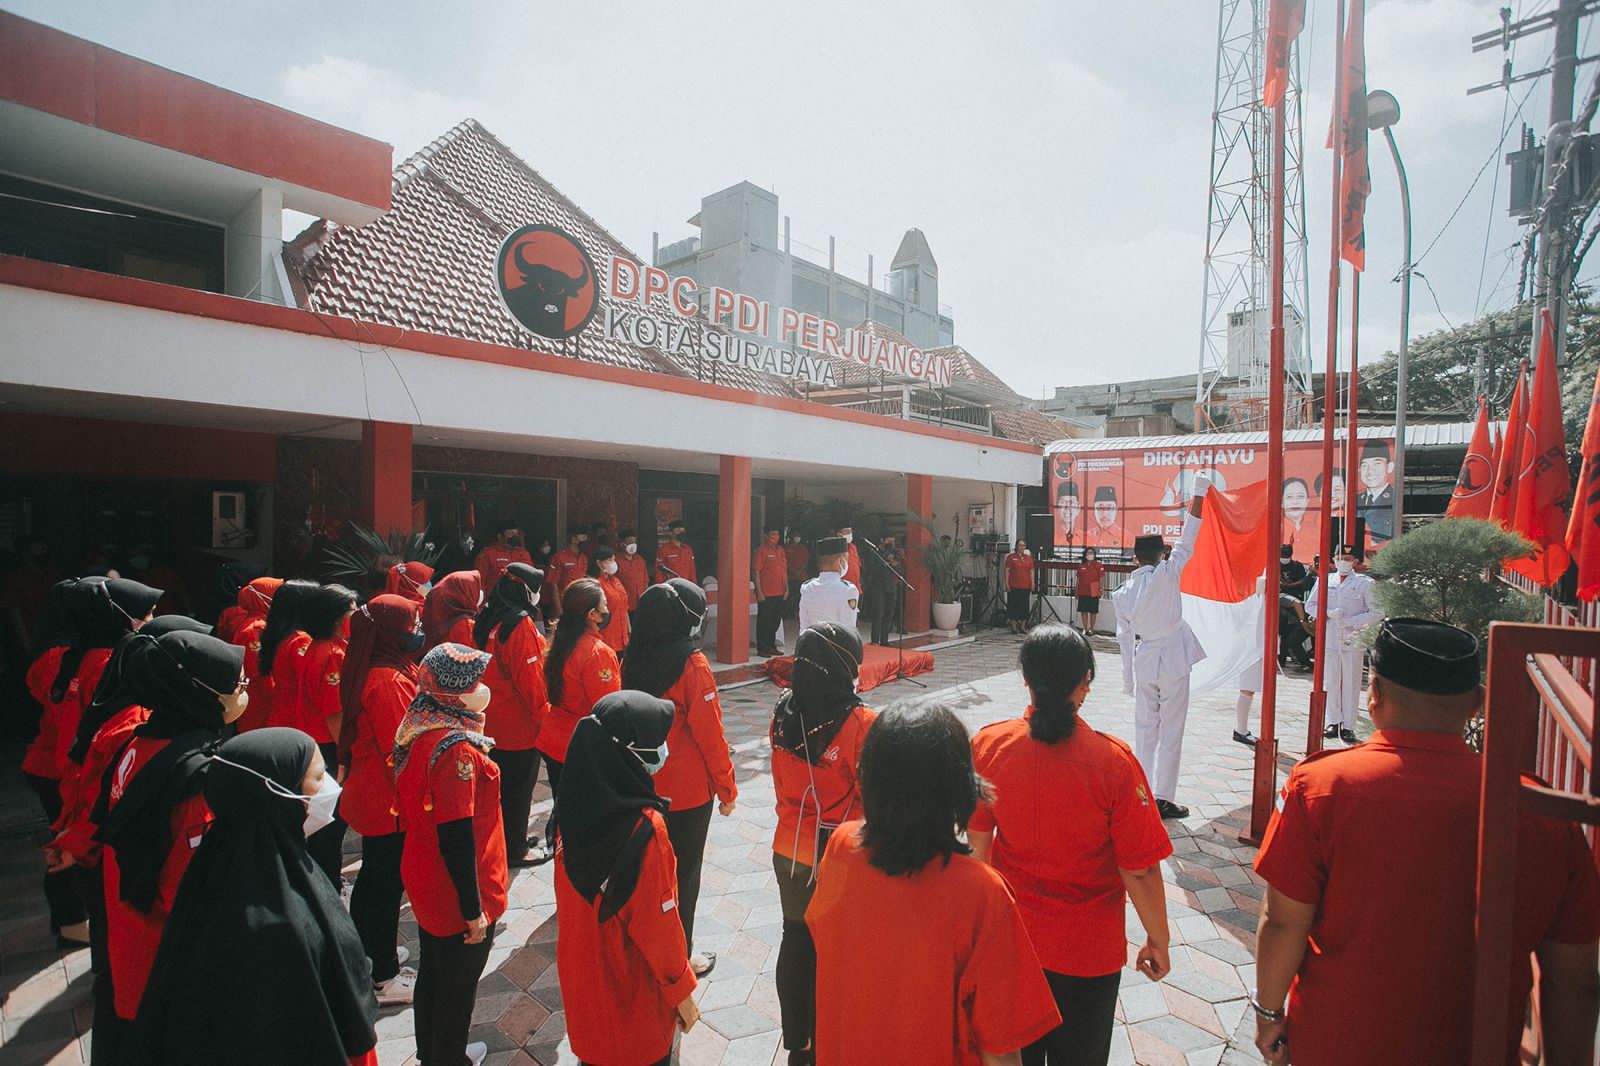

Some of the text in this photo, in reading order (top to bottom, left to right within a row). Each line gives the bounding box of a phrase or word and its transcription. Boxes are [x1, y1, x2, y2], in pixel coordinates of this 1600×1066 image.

[609, 256, 952, 386] DPC PDI PERJUANGAN
[608, 308, 837, 386] KOTA SURABAYA
[1143, 448, 1254, 466] DIRGAHAYU
[1143, 524, 1183, 536] PDI PE
